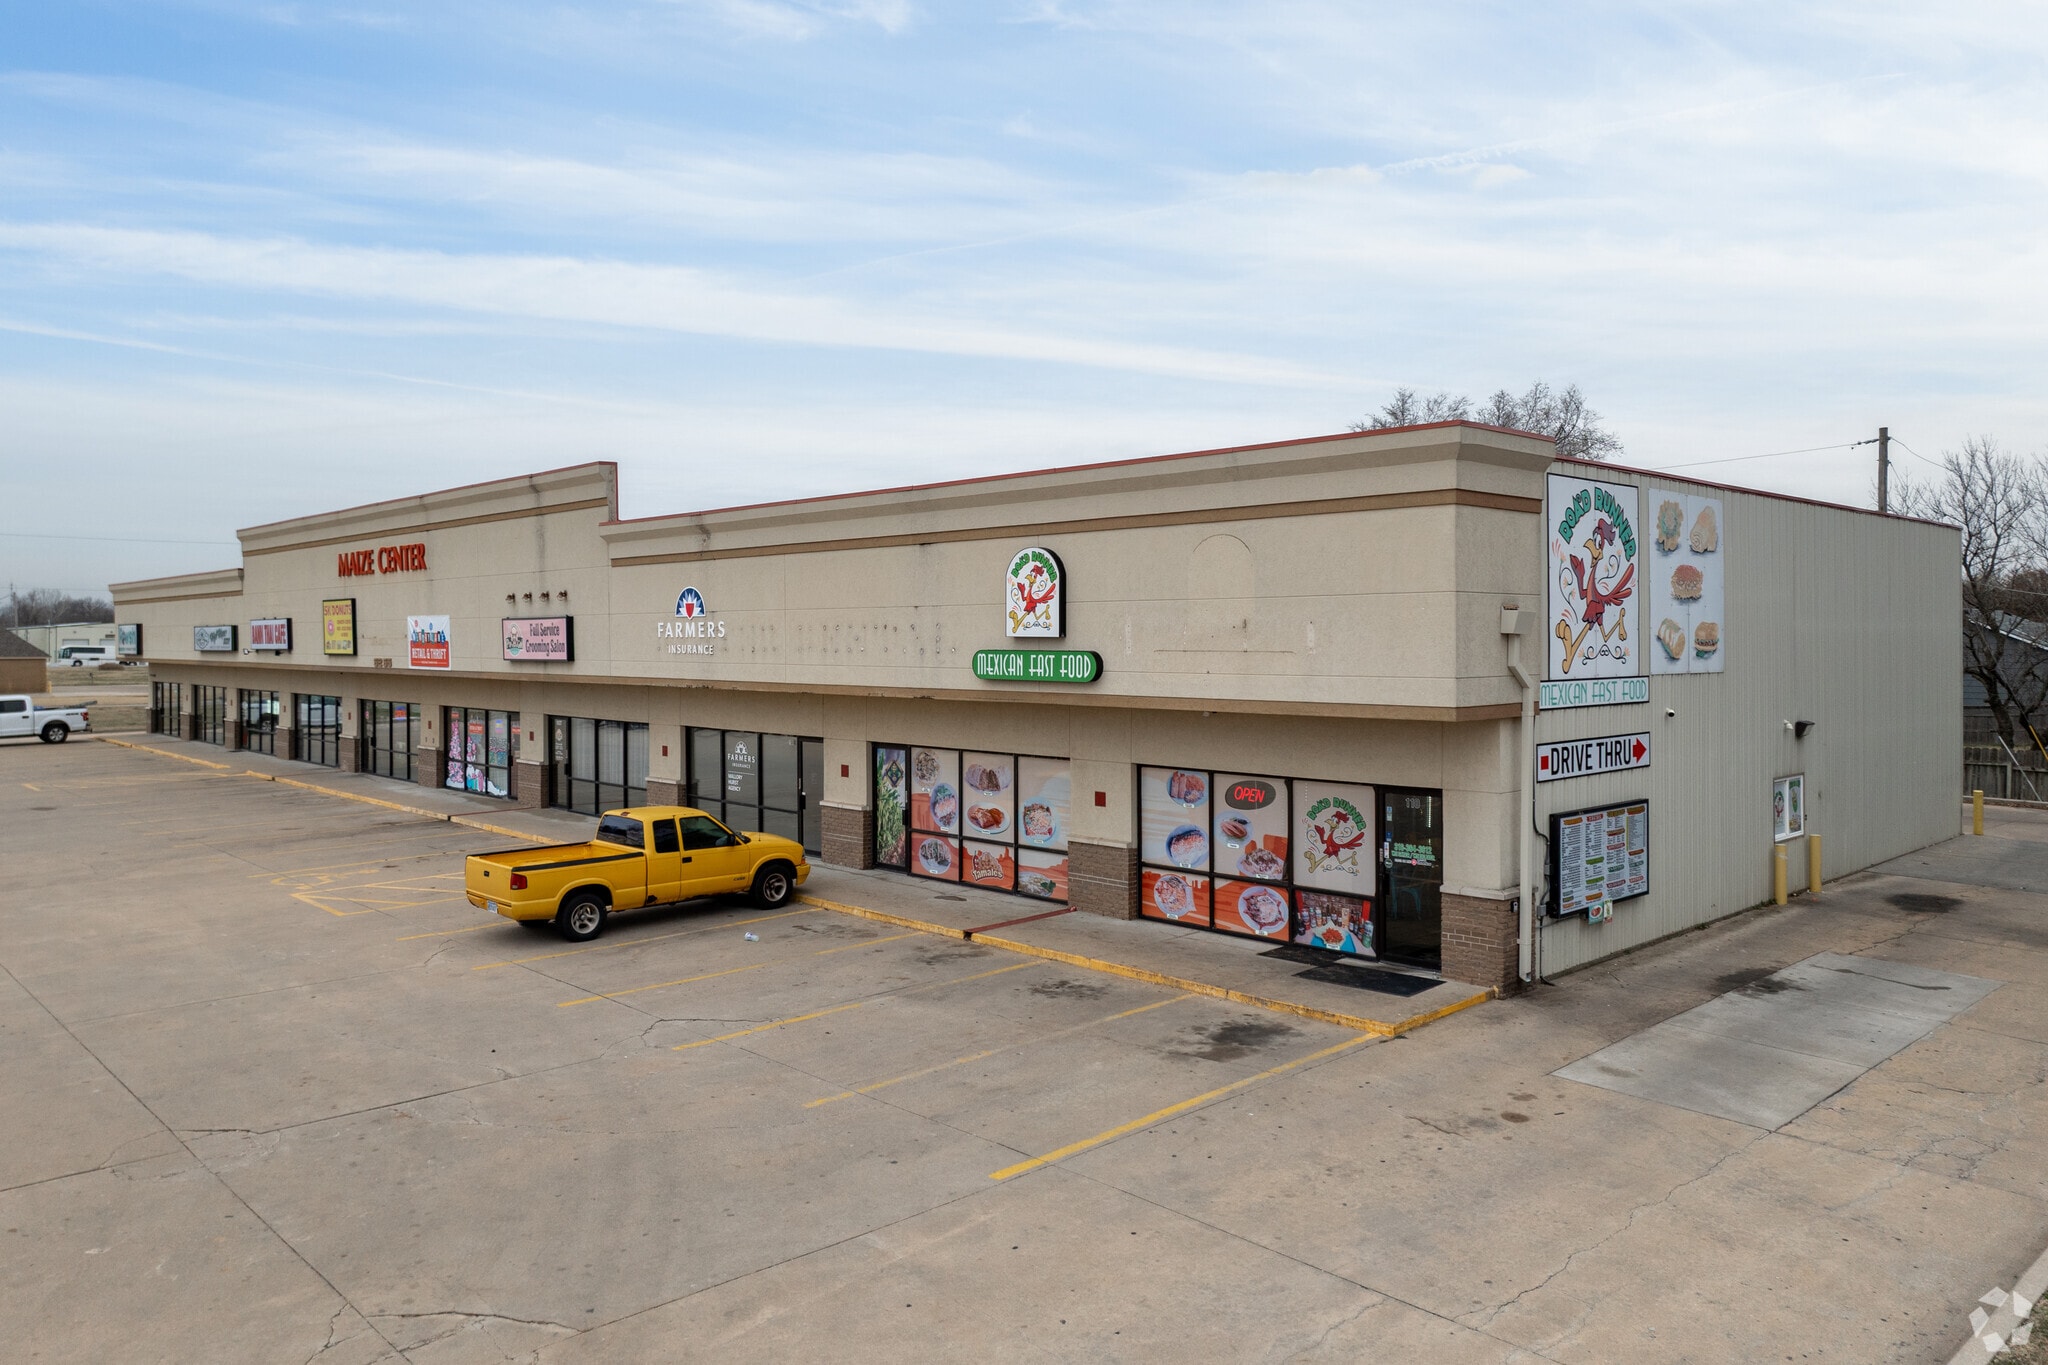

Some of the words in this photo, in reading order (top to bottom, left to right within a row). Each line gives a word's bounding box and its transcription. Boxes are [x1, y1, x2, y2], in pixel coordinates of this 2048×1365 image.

[1558, 488, 1591, 544] ROAD
[1594, 487, 1637, 562] RUNNER
[338, 550, 375, 577] MAIZE
[377, 543, 427, 574] CENTER
[1011, 553, 1030, 578] ROAD
[1031, 551, 1058, 583] RUNNER
[530, 623, 539, 636] Full
[540, 622, 560, 636] Service
[657, 621, 725, 638] FARMERS
[525, 639, 550, 656] Grooming
[550, 639, 566, 653] Salon
[668, 644, 714, 655] INSURANCE
[977, 653, 1023, 676] MEXICAN
[1028, 655, 1055, 677] FAST
[1060, 655, 1091, 678] FOOD
[1541, 683, 1587, 706] MEXICAN
[1592, 681, 1617, 702] FAST
[1622, 680, 1647, 700] FOOD
[727, 753, 756, 763] FARMERS
[1551, 744, 1593, 775] DRIVE
[1596, 739, 1631, 769] THRU
[1234, 786, 1265, 803] OPEN
[1306, 798, 1331, 820] ROAD
[1333, 797, 1367, 831] RUNNER
[972, 868, 1003, 881] Tamales
